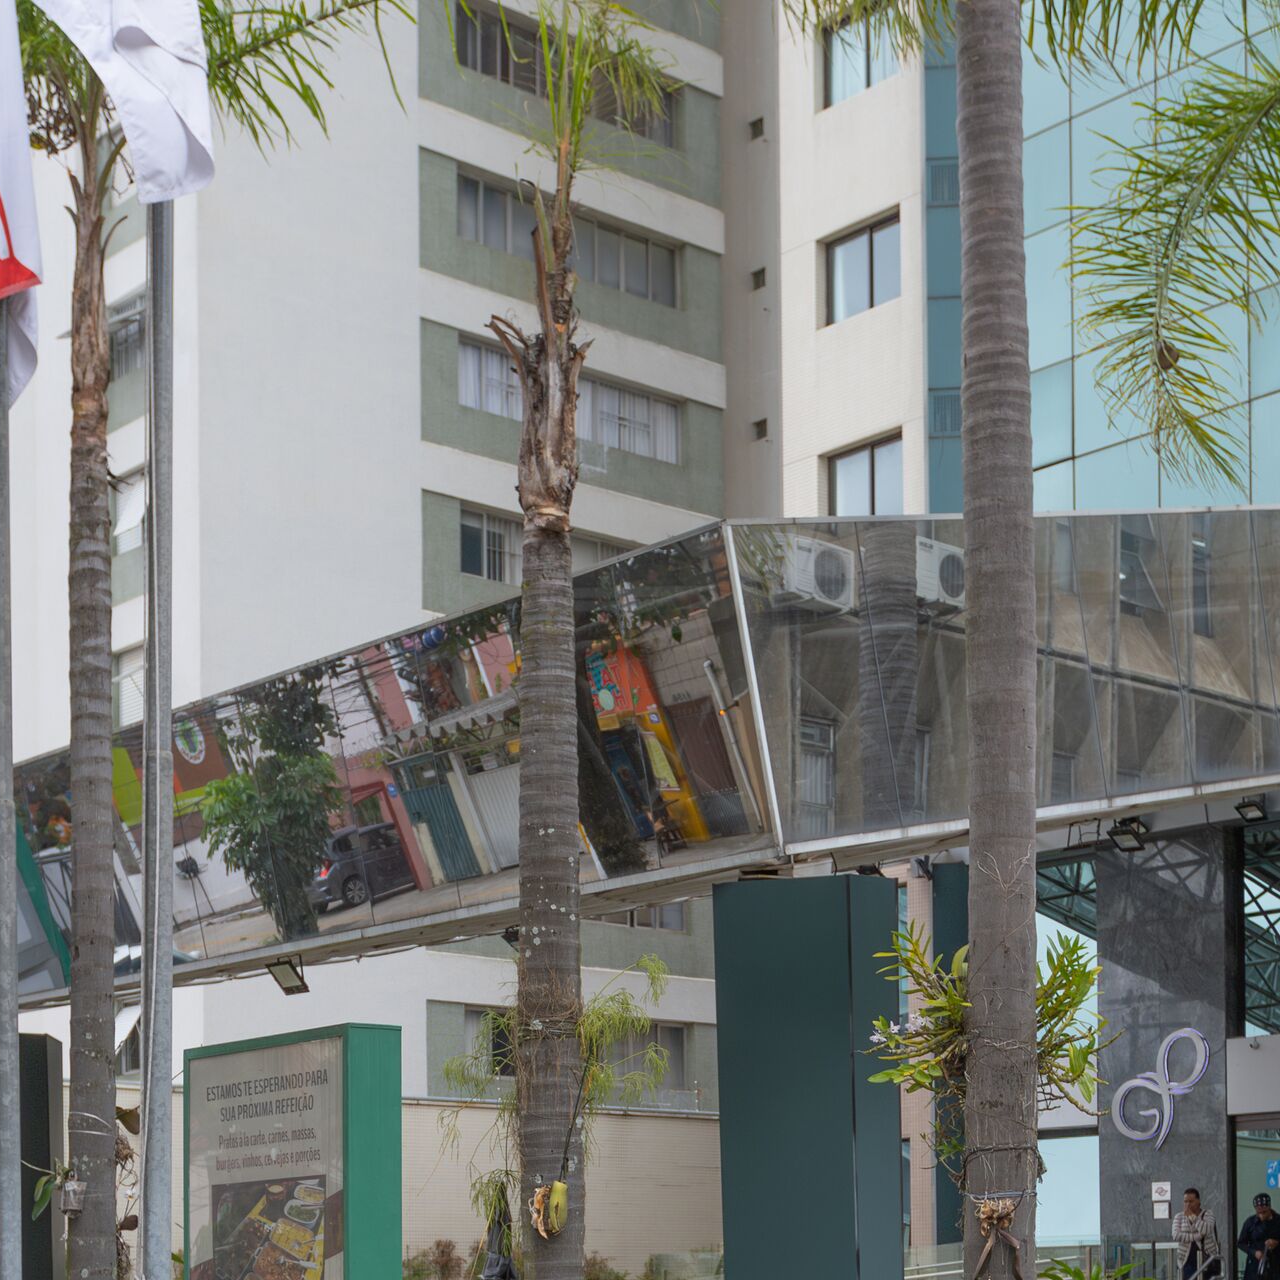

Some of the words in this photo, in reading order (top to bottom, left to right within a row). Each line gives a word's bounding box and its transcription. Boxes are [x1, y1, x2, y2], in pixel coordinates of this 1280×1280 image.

[206, 1081, 242, 1102] ESTAMOS
[243, 1080, 253, 1097] TE
[254, 1072, 304, 1095] ESPERANDO
[305, 1068, 329, 1087] PARA
[220, 1106, 236, 1122] SUA
[237, 1098, 274, 1120] PRÓXIMA
[275, 1093, 315, 1117] REFEIÇÃO
[218, 1132, 239, 1150] Pratos
[291, 1127, 317, 1142] massas,
[295, 1147, 321, 1168] porções
